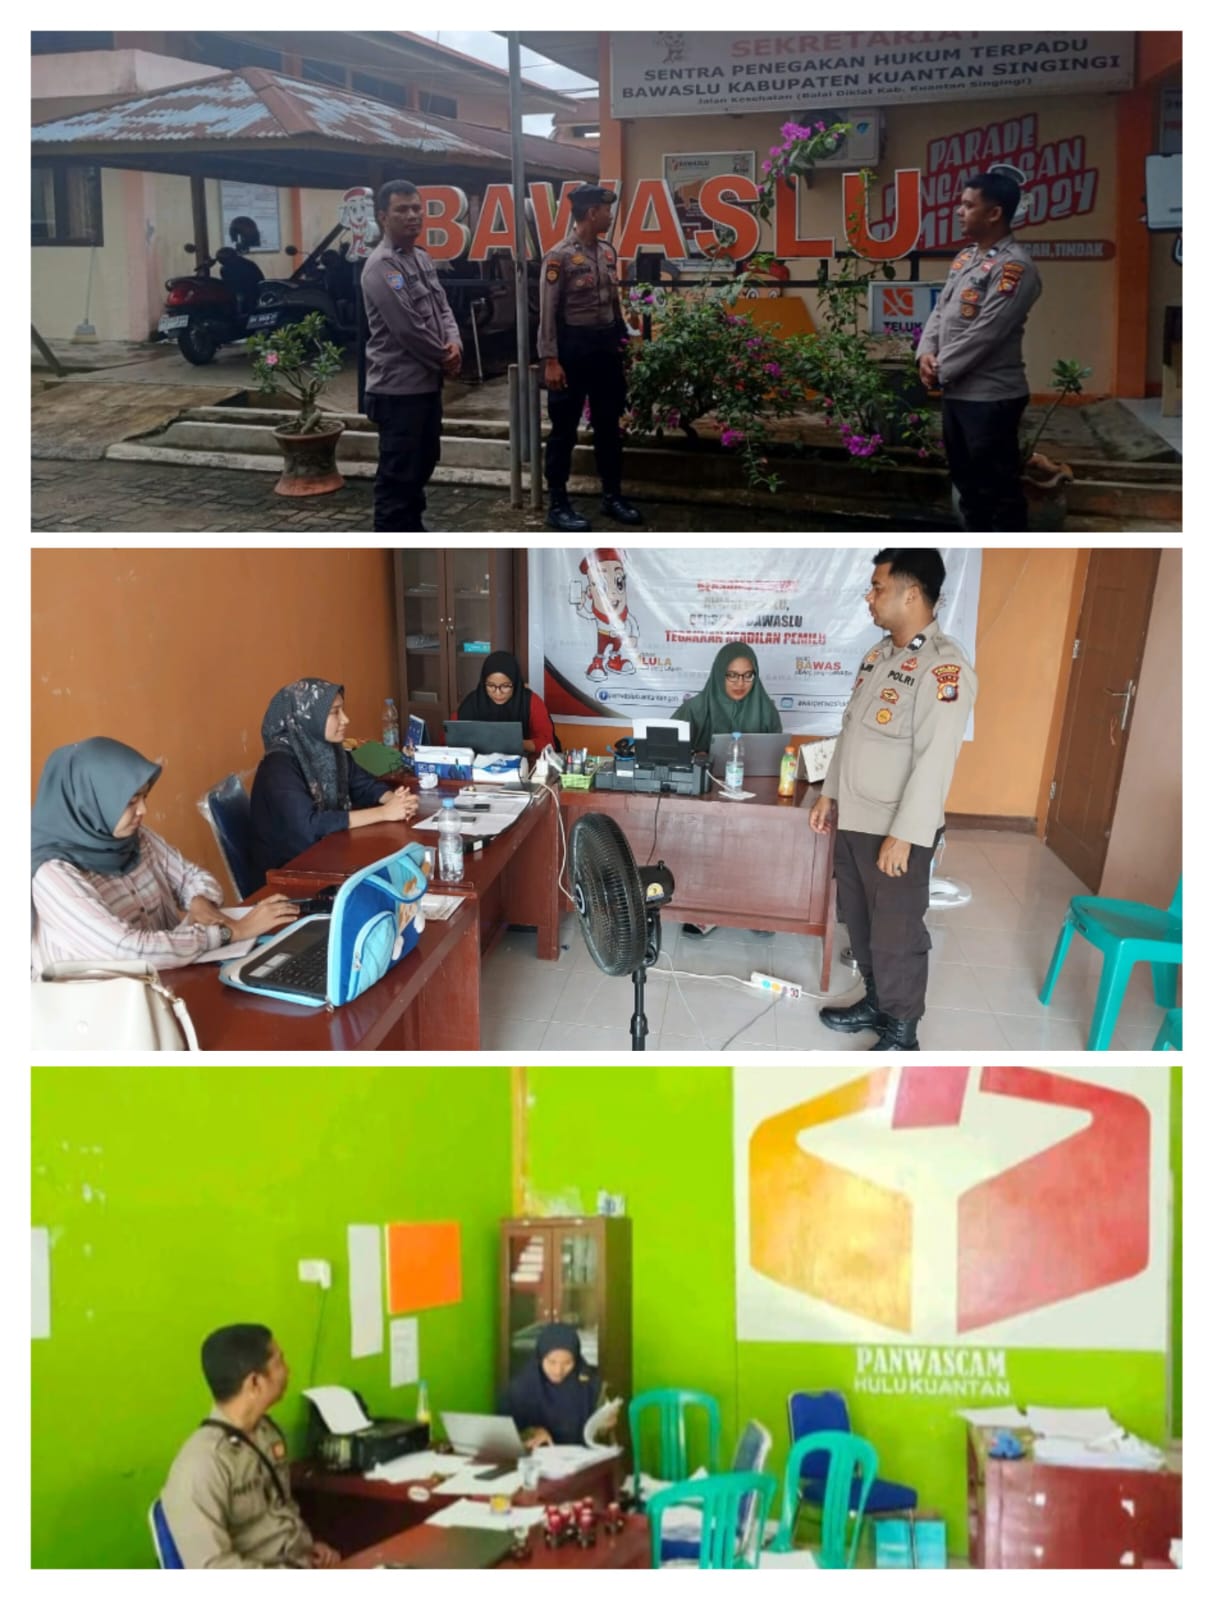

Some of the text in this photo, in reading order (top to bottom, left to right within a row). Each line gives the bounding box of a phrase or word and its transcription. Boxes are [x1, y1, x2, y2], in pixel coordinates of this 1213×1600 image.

[622, 55, 1121, 99] BAWASLU KABUPATEN KUANTAN SINGINGI
[644, 39, 1088, 82] SENTRA PENEGAKAN HUKUM TERPADU
[930, 114, 1035, 172] PARADE
[885, 136, 1085, 218] PNGASAN
[415, 168, 921, 262] BAWASLU
[745, 614, 803, 628] AWASLU
[783, 632, 827, 645] PEMILU
[887, 670, 915, 687] POLRI
[857, 1346, 1006, 1377] PANWASCAM
